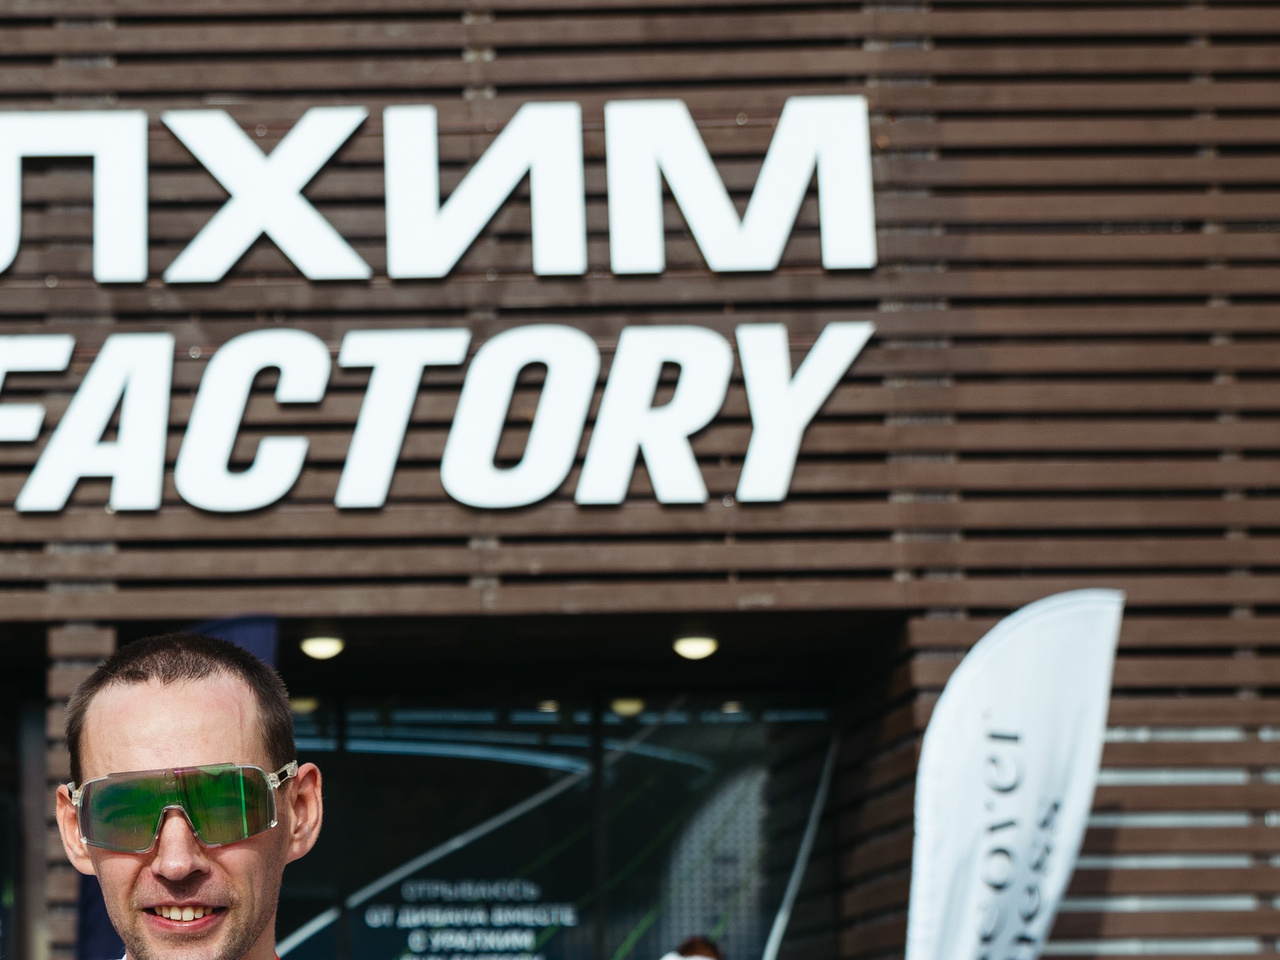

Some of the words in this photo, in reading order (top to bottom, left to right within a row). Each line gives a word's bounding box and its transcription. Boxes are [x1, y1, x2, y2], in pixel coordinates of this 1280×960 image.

[365, 905, 394, 928] ОТ
[397, 905, 489, 928] ДИВАНА
[491, 904, 577, 926] ВМЕСТЕ
[429, 928, 536, 951] УРАЛХИМ
